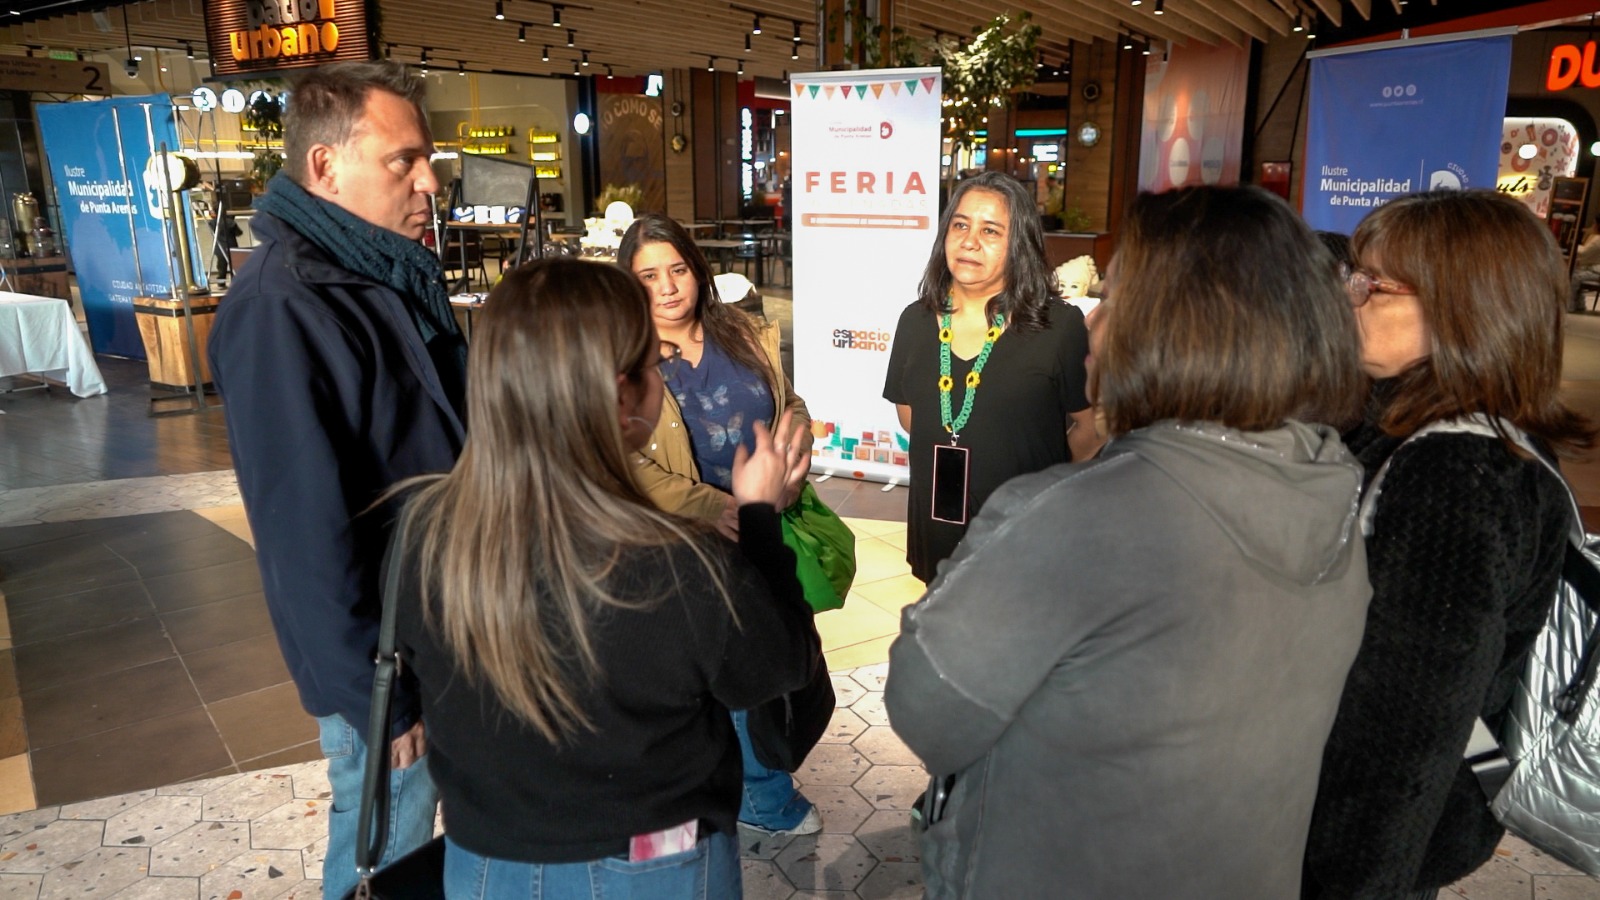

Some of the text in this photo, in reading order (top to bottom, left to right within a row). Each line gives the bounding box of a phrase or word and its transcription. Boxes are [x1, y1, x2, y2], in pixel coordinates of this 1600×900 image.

[82, 66, 103, 90] 2
[613, 98, 647, 117] COMO
[828, 125, 872, 134] Municipalidad
[64, 164, 85, 178] Ilustre
[1321, 165, 1348, 176] Ilustre
[1447, 162, 1469, 184] CIUDAD
[805, 171, 927, 195] FERIA
[1320, 178, 1411, 195] Municipalidad
[80, 200, 89, 213] de
[89, 201, 111, 214] Punta
[1330, 194, 1342, 206] de
[1342, 196, 1371, 207] Punta
[833, 328, 890, 341] espacio
[833, 338, 887, 352] urbano
